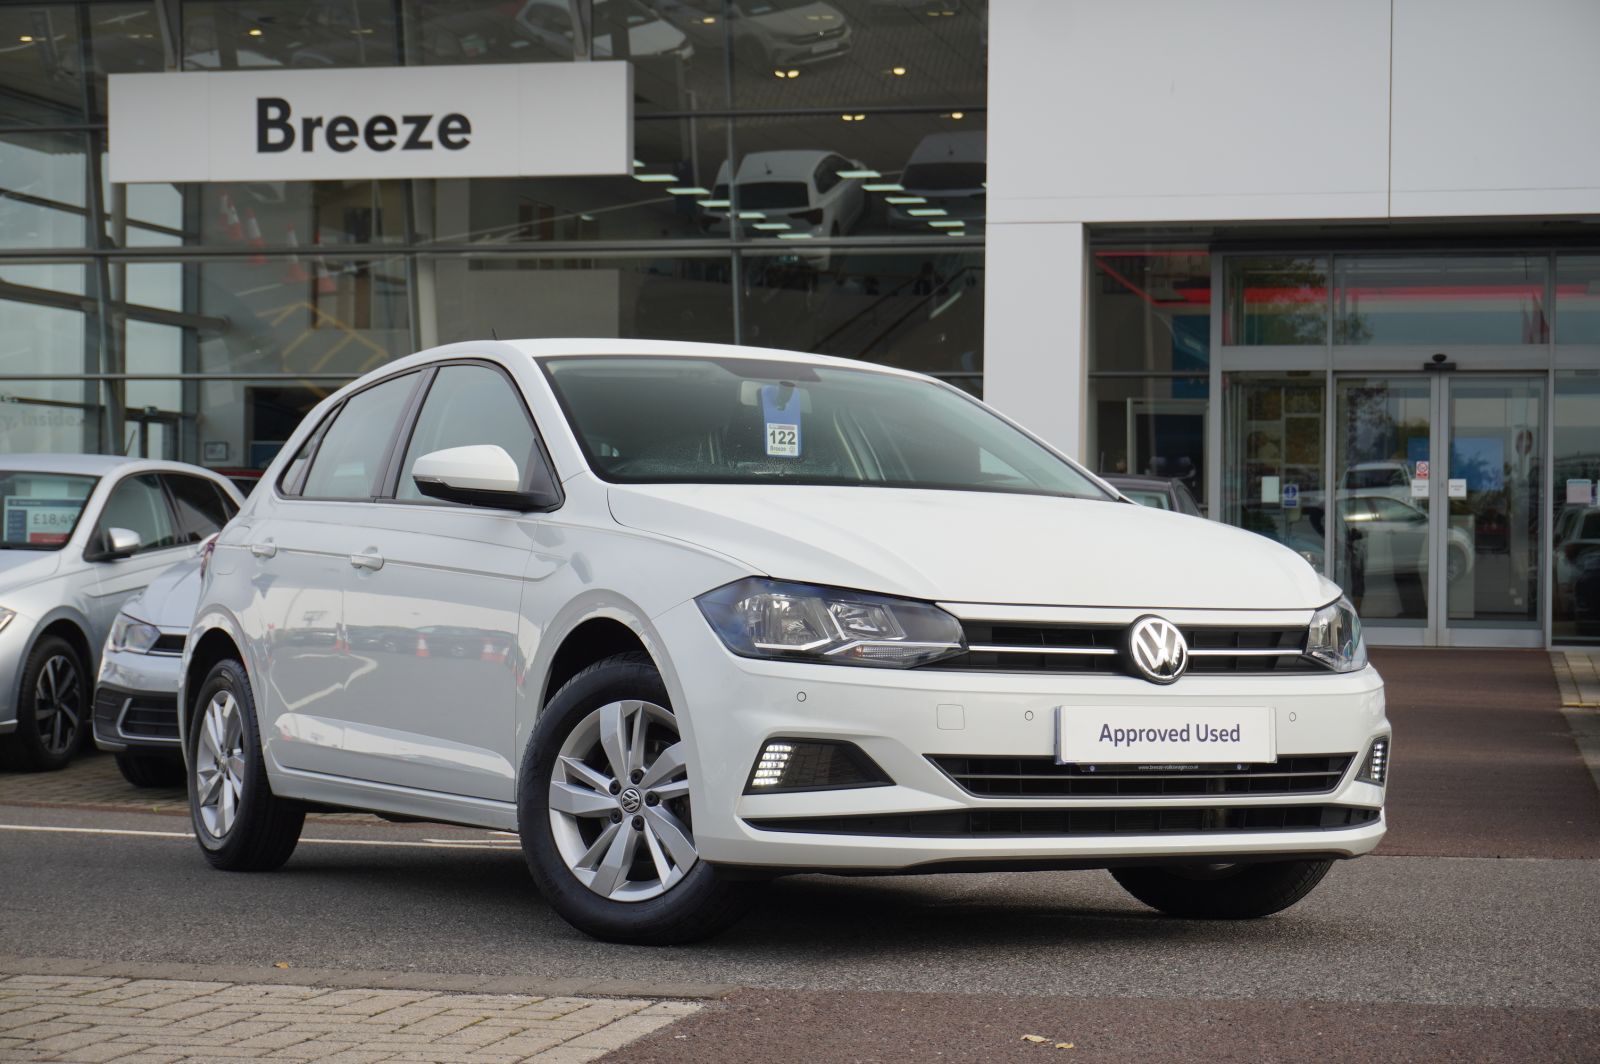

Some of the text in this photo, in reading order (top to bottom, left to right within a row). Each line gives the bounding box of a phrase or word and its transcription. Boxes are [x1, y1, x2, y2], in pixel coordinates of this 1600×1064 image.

[256, 97, 472, 153] Breeze
[769, 430, 796, 446] 122
[1099, 723, 1240, 747] Approved Used
